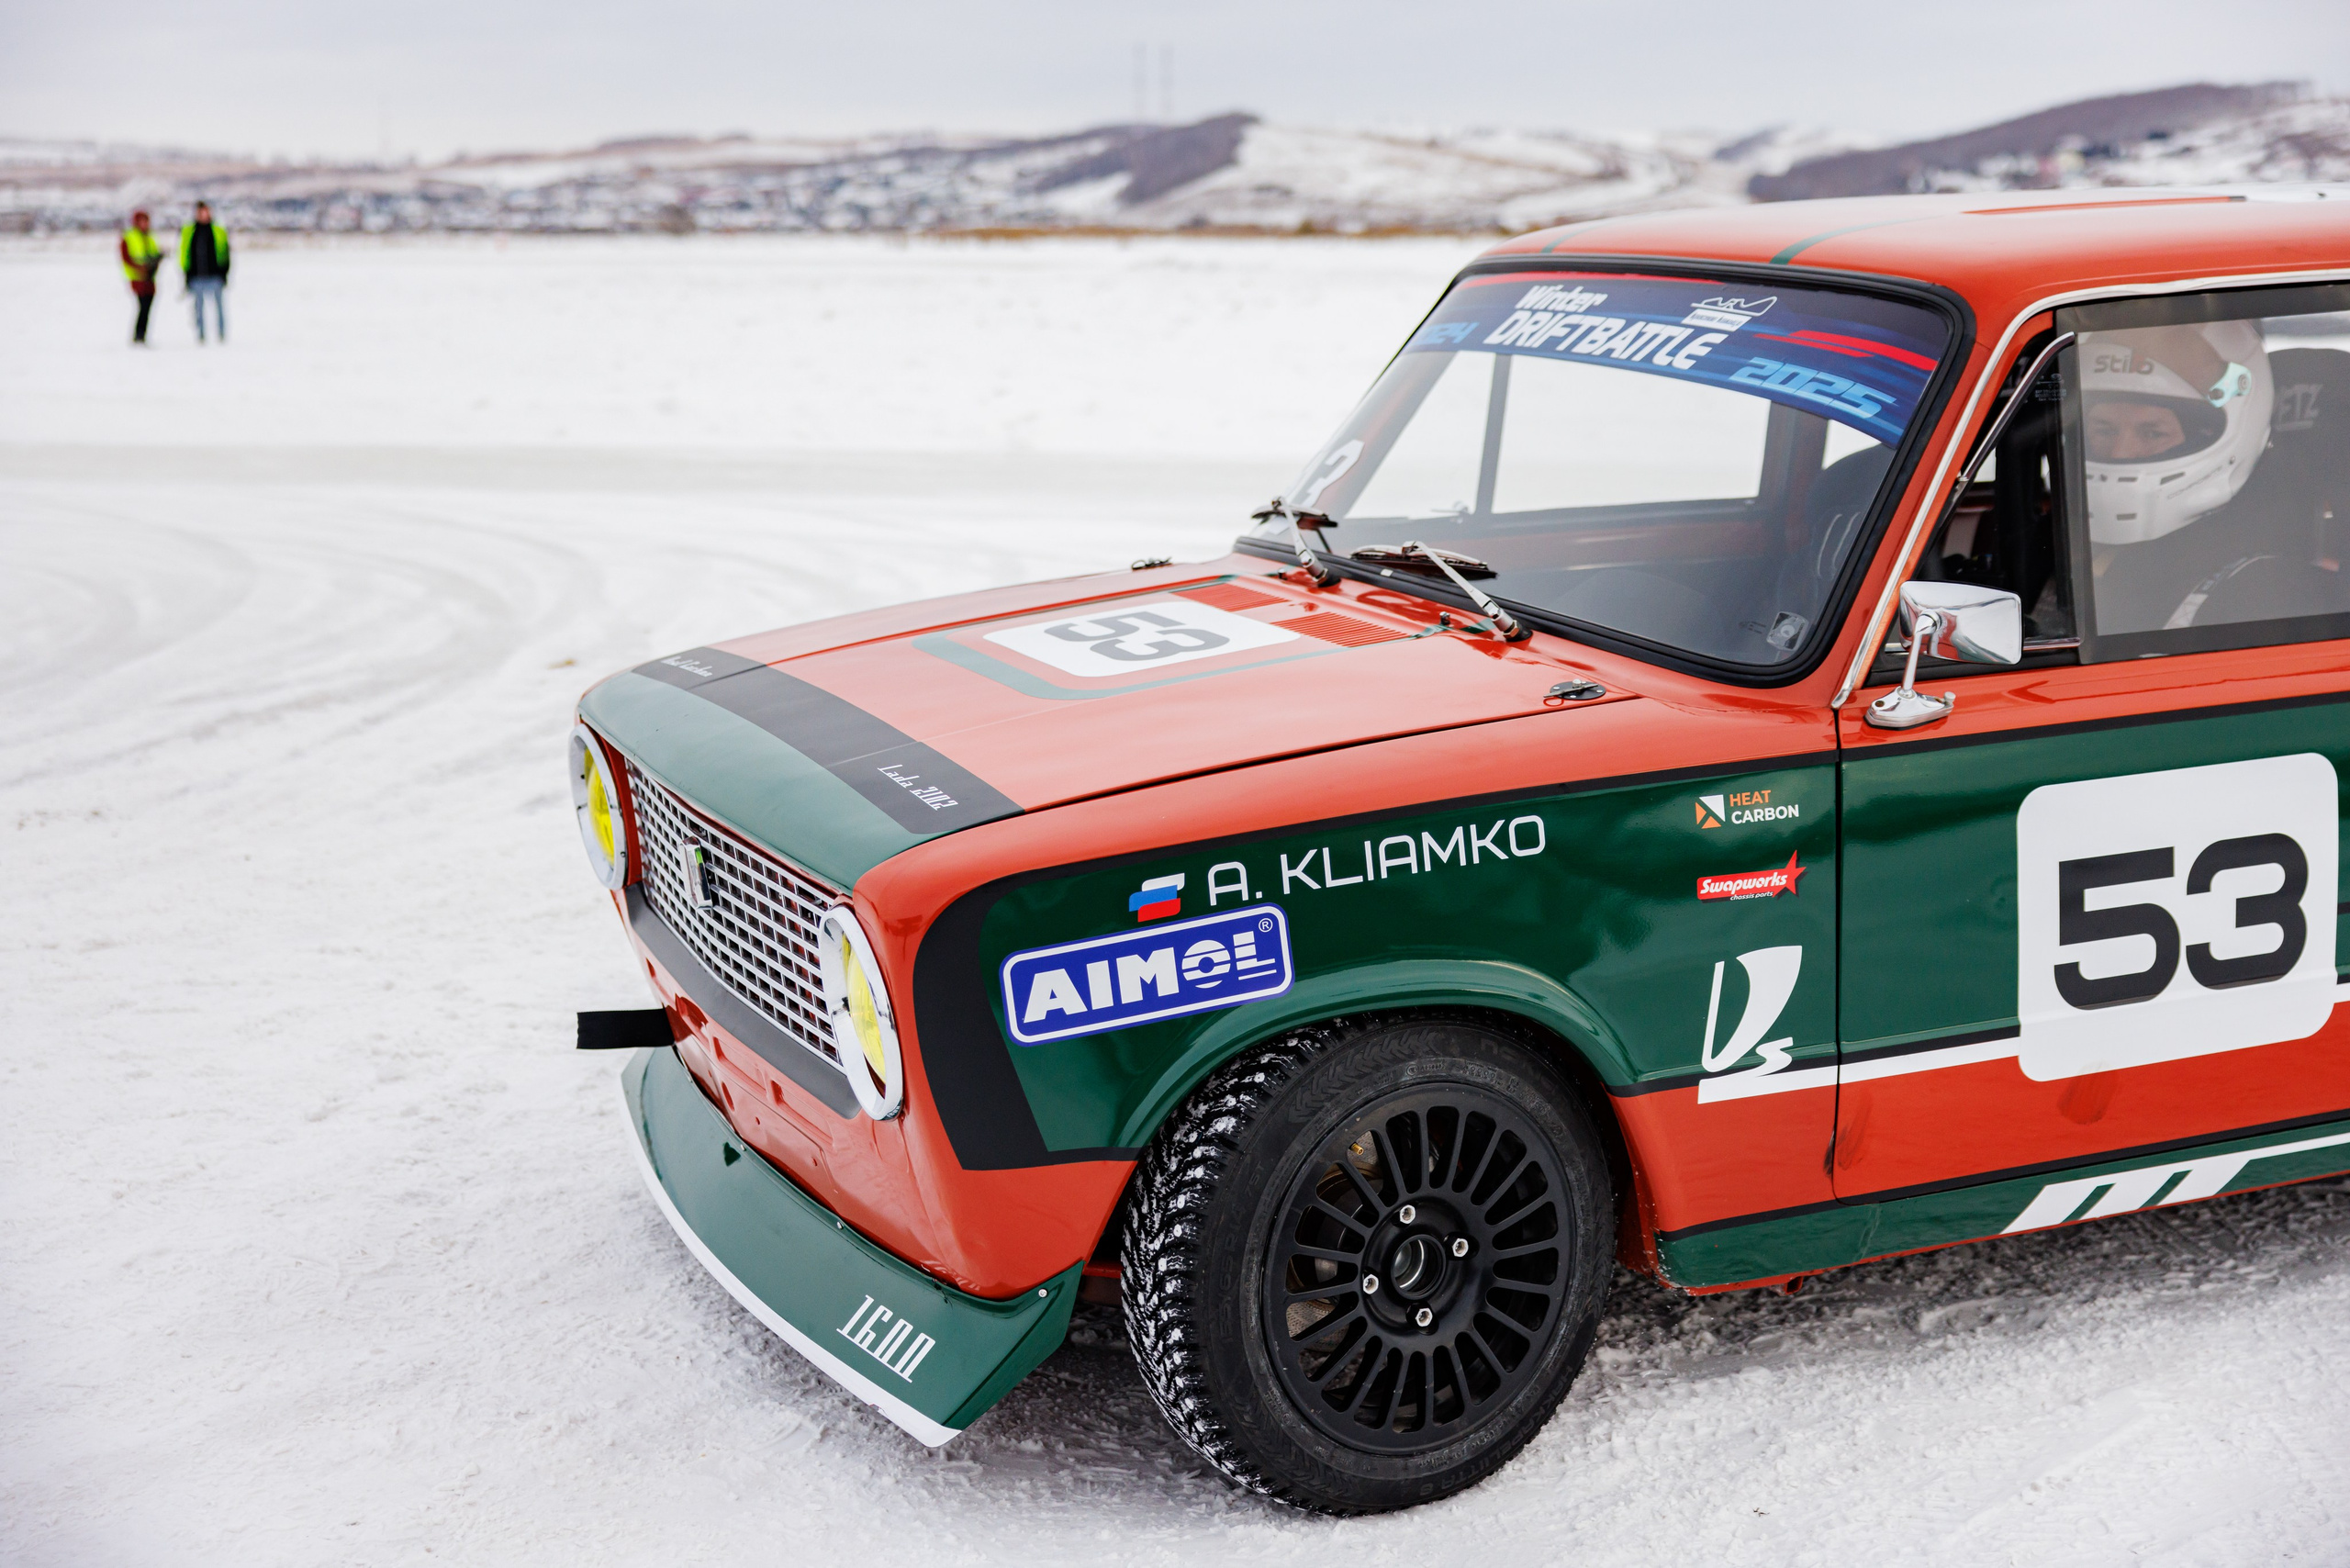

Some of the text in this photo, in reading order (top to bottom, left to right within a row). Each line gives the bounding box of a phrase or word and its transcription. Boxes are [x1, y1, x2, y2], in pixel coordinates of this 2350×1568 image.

[1516, 285, 1607, 312] Winter
[1483, 310, 1729, 370] DRIFTBATTLE
[1729, 357, 1897, 419] 2025
[1044, 611, 1230, 662] 53
[877, 764, 959, 811] Lada 2102
[1729, 790, 1772, 807] HEAT
[1731, 804, 1799, 824] CARBON
[1207, 814, 1546, 906] A. KLIAMKO
[1700, 872, 1788, 895] Swapworks
[2053, 833, 2309, 1011] 53
[1023, 930, 1277, 1024] AIMOL
[836, 1294, 936, 1383] 1600
